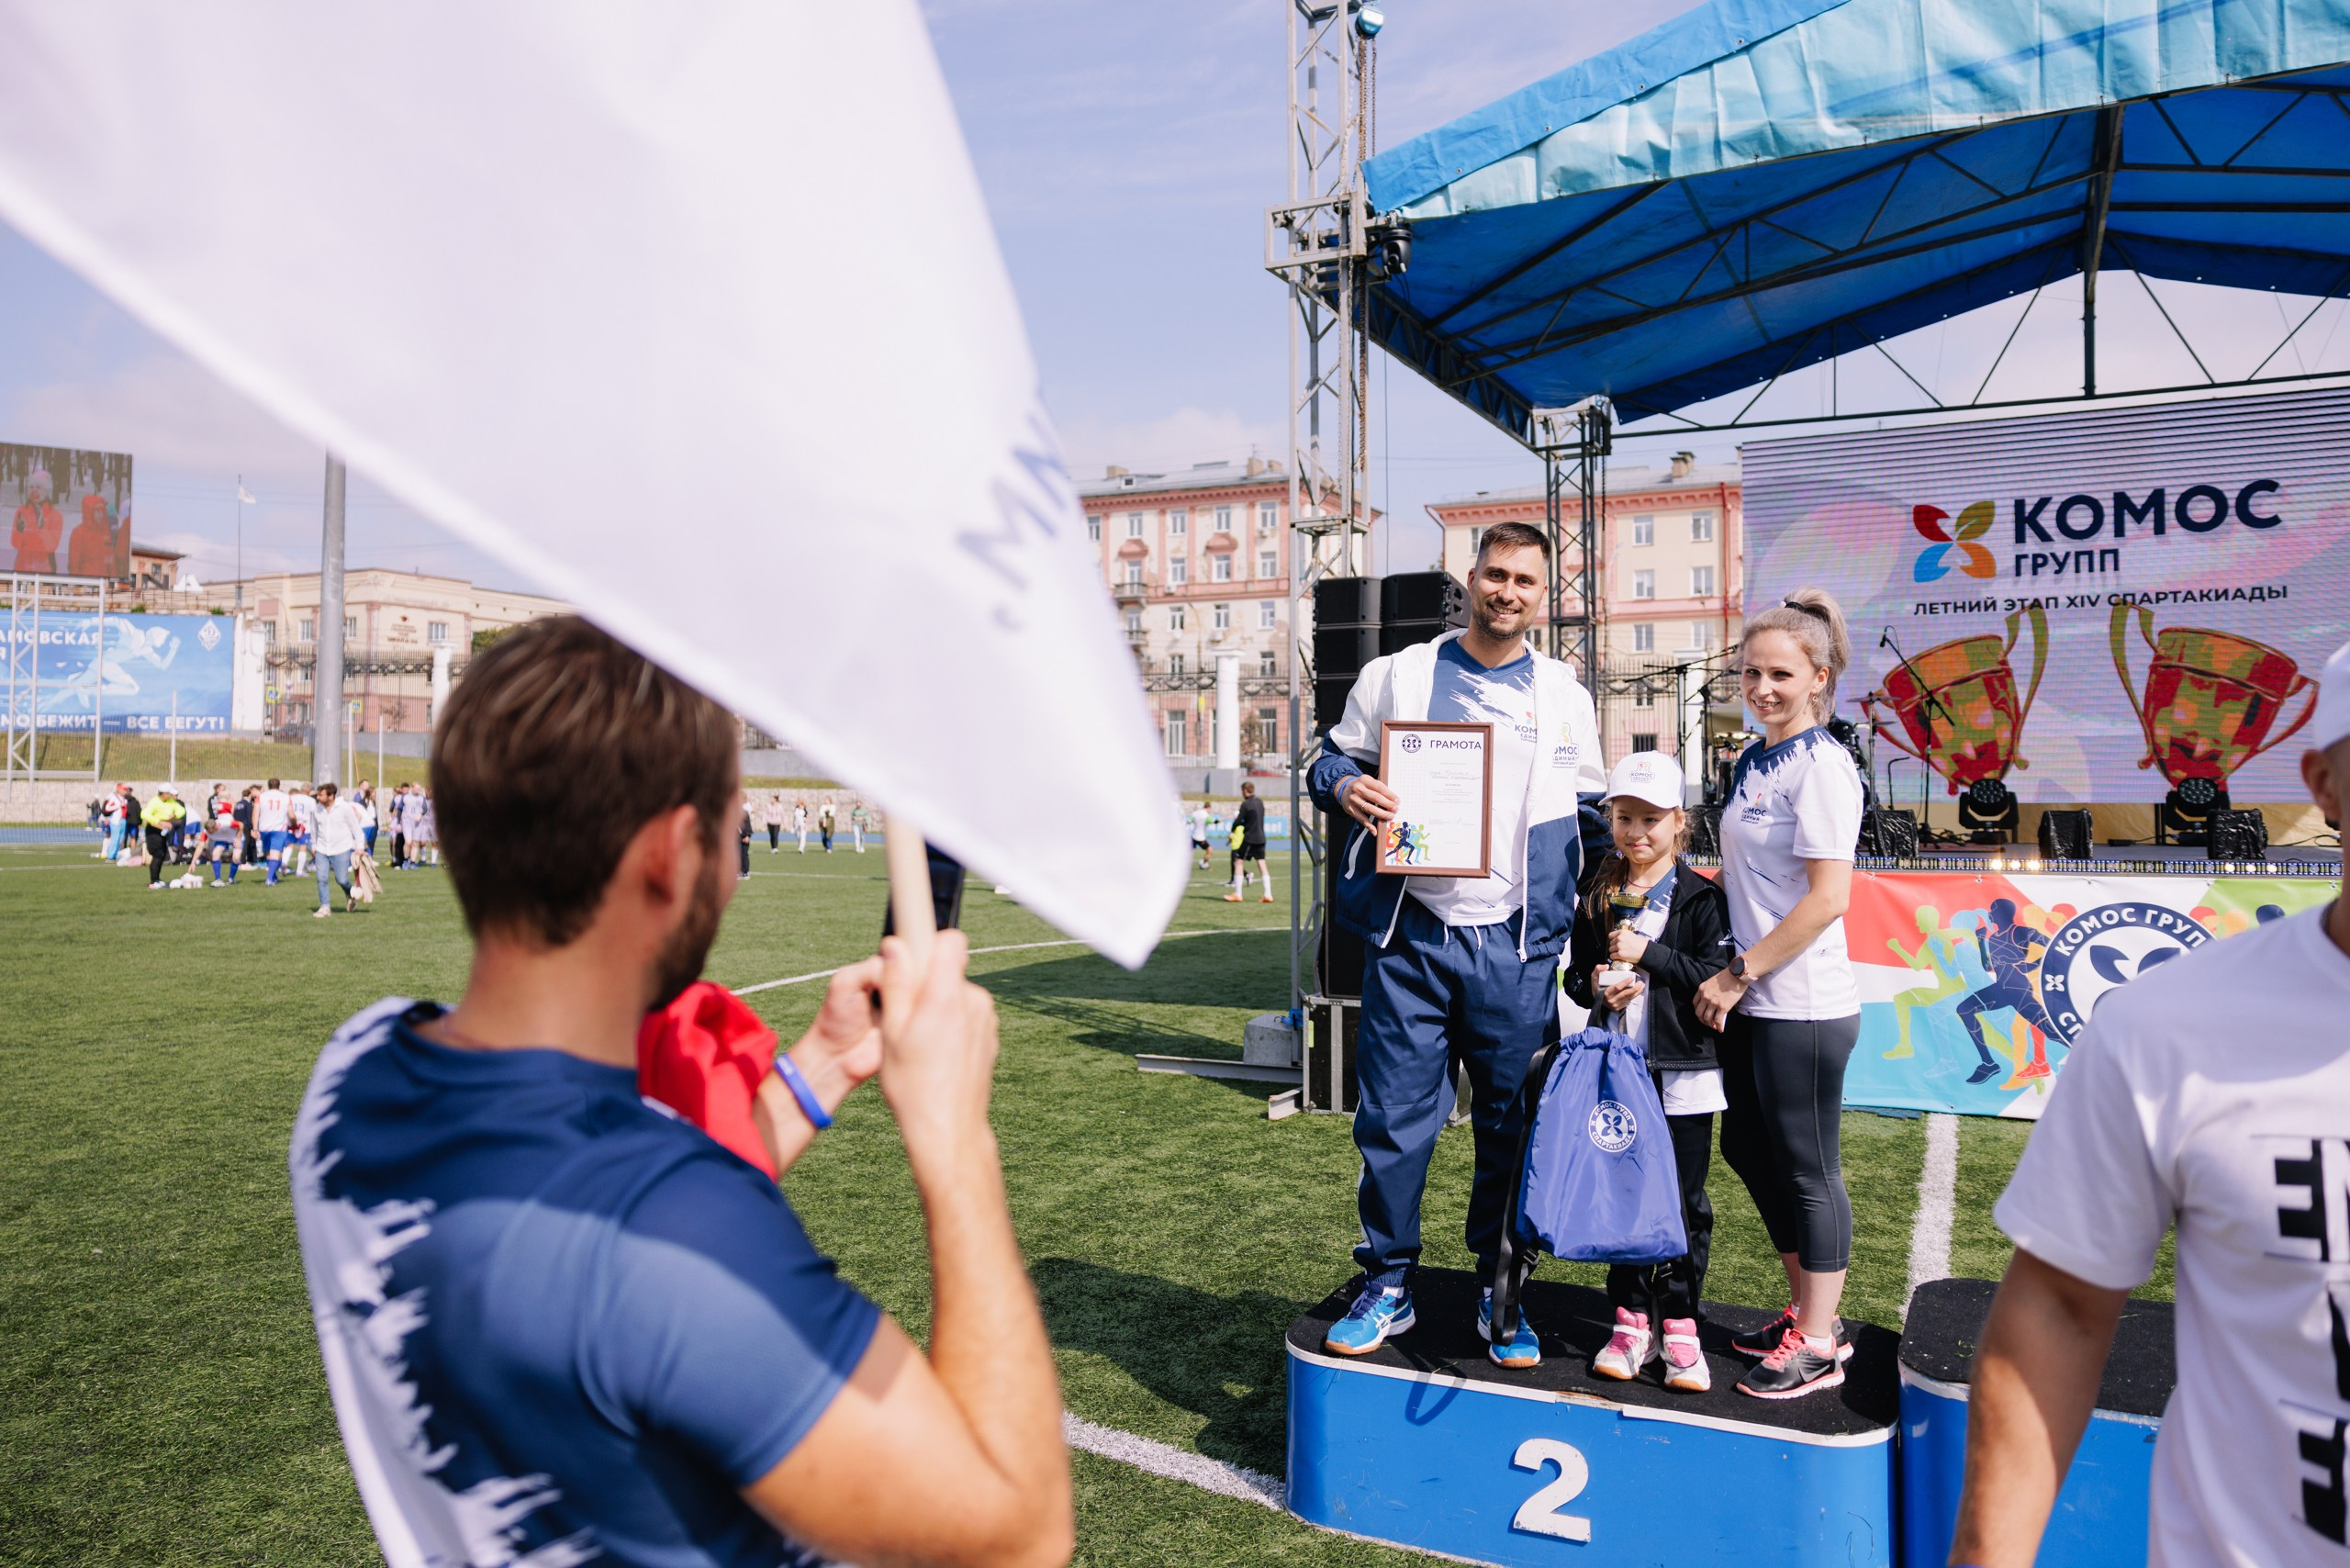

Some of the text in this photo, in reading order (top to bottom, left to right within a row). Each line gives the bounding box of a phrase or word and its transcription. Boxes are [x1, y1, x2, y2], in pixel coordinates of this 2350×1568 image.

[2014, 479, 2282, 543] КОМОС
[2015, 548, 2120, 577] ГРУПП
[1914, 586, 2287, 615] ЛЕТНИЙ ЭТАП XIV СПАРТАКИАДЫ
[36, 714, 98, 728] БЕЖИТ
[127, 715, 160, 729] ВСЕ
[165, 716, 224, 730] БЕГУТ!
[1430, 740, 1482, 749] ГРАМОТА
[2054, 907, 2136, 957] КОМОС
[1594, 1103, 1632, 1121] КОМОС ГРУПП
[1592, 1131, 1633, 1150] СПАРТАКИАДА
[1513, 1438, 1592, 1542] 2
